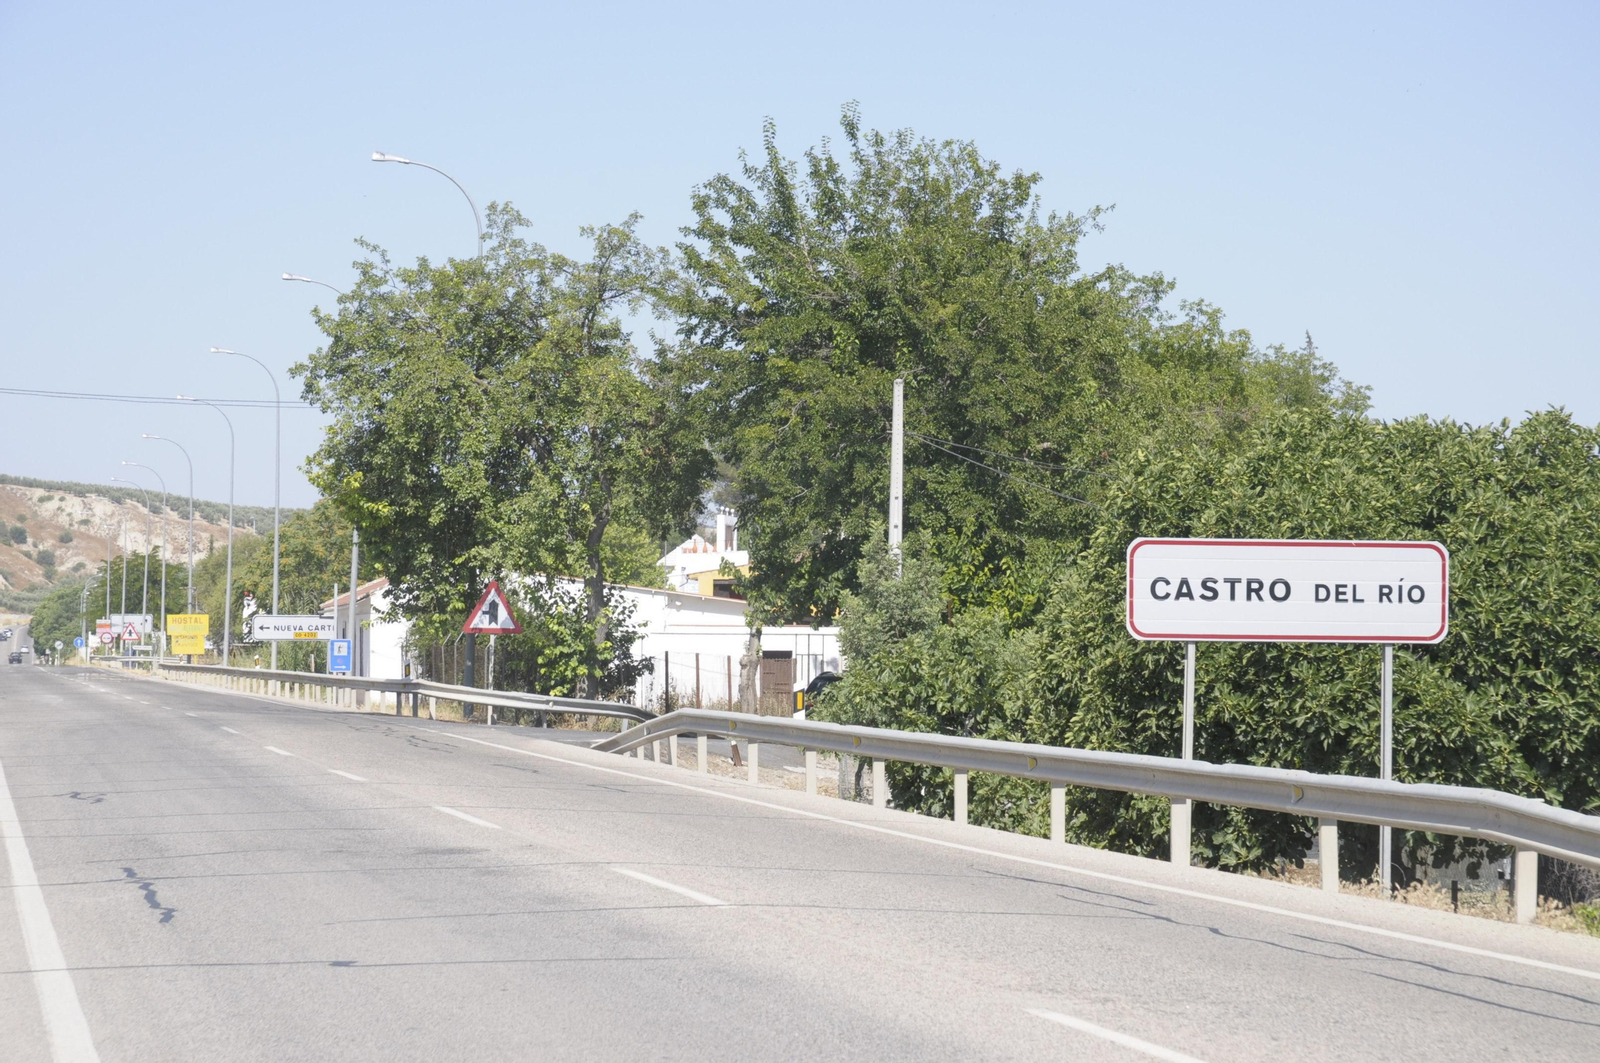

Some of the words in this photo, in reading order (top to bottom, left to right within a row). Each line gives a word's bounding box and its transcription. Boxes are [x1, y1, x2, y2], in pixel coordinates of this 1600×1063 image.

[1150, 577, 1291, 602] CASTRO
[1315, 584, 1365, 603] DEL
[1378, 578, 1426, 604] RÍO
